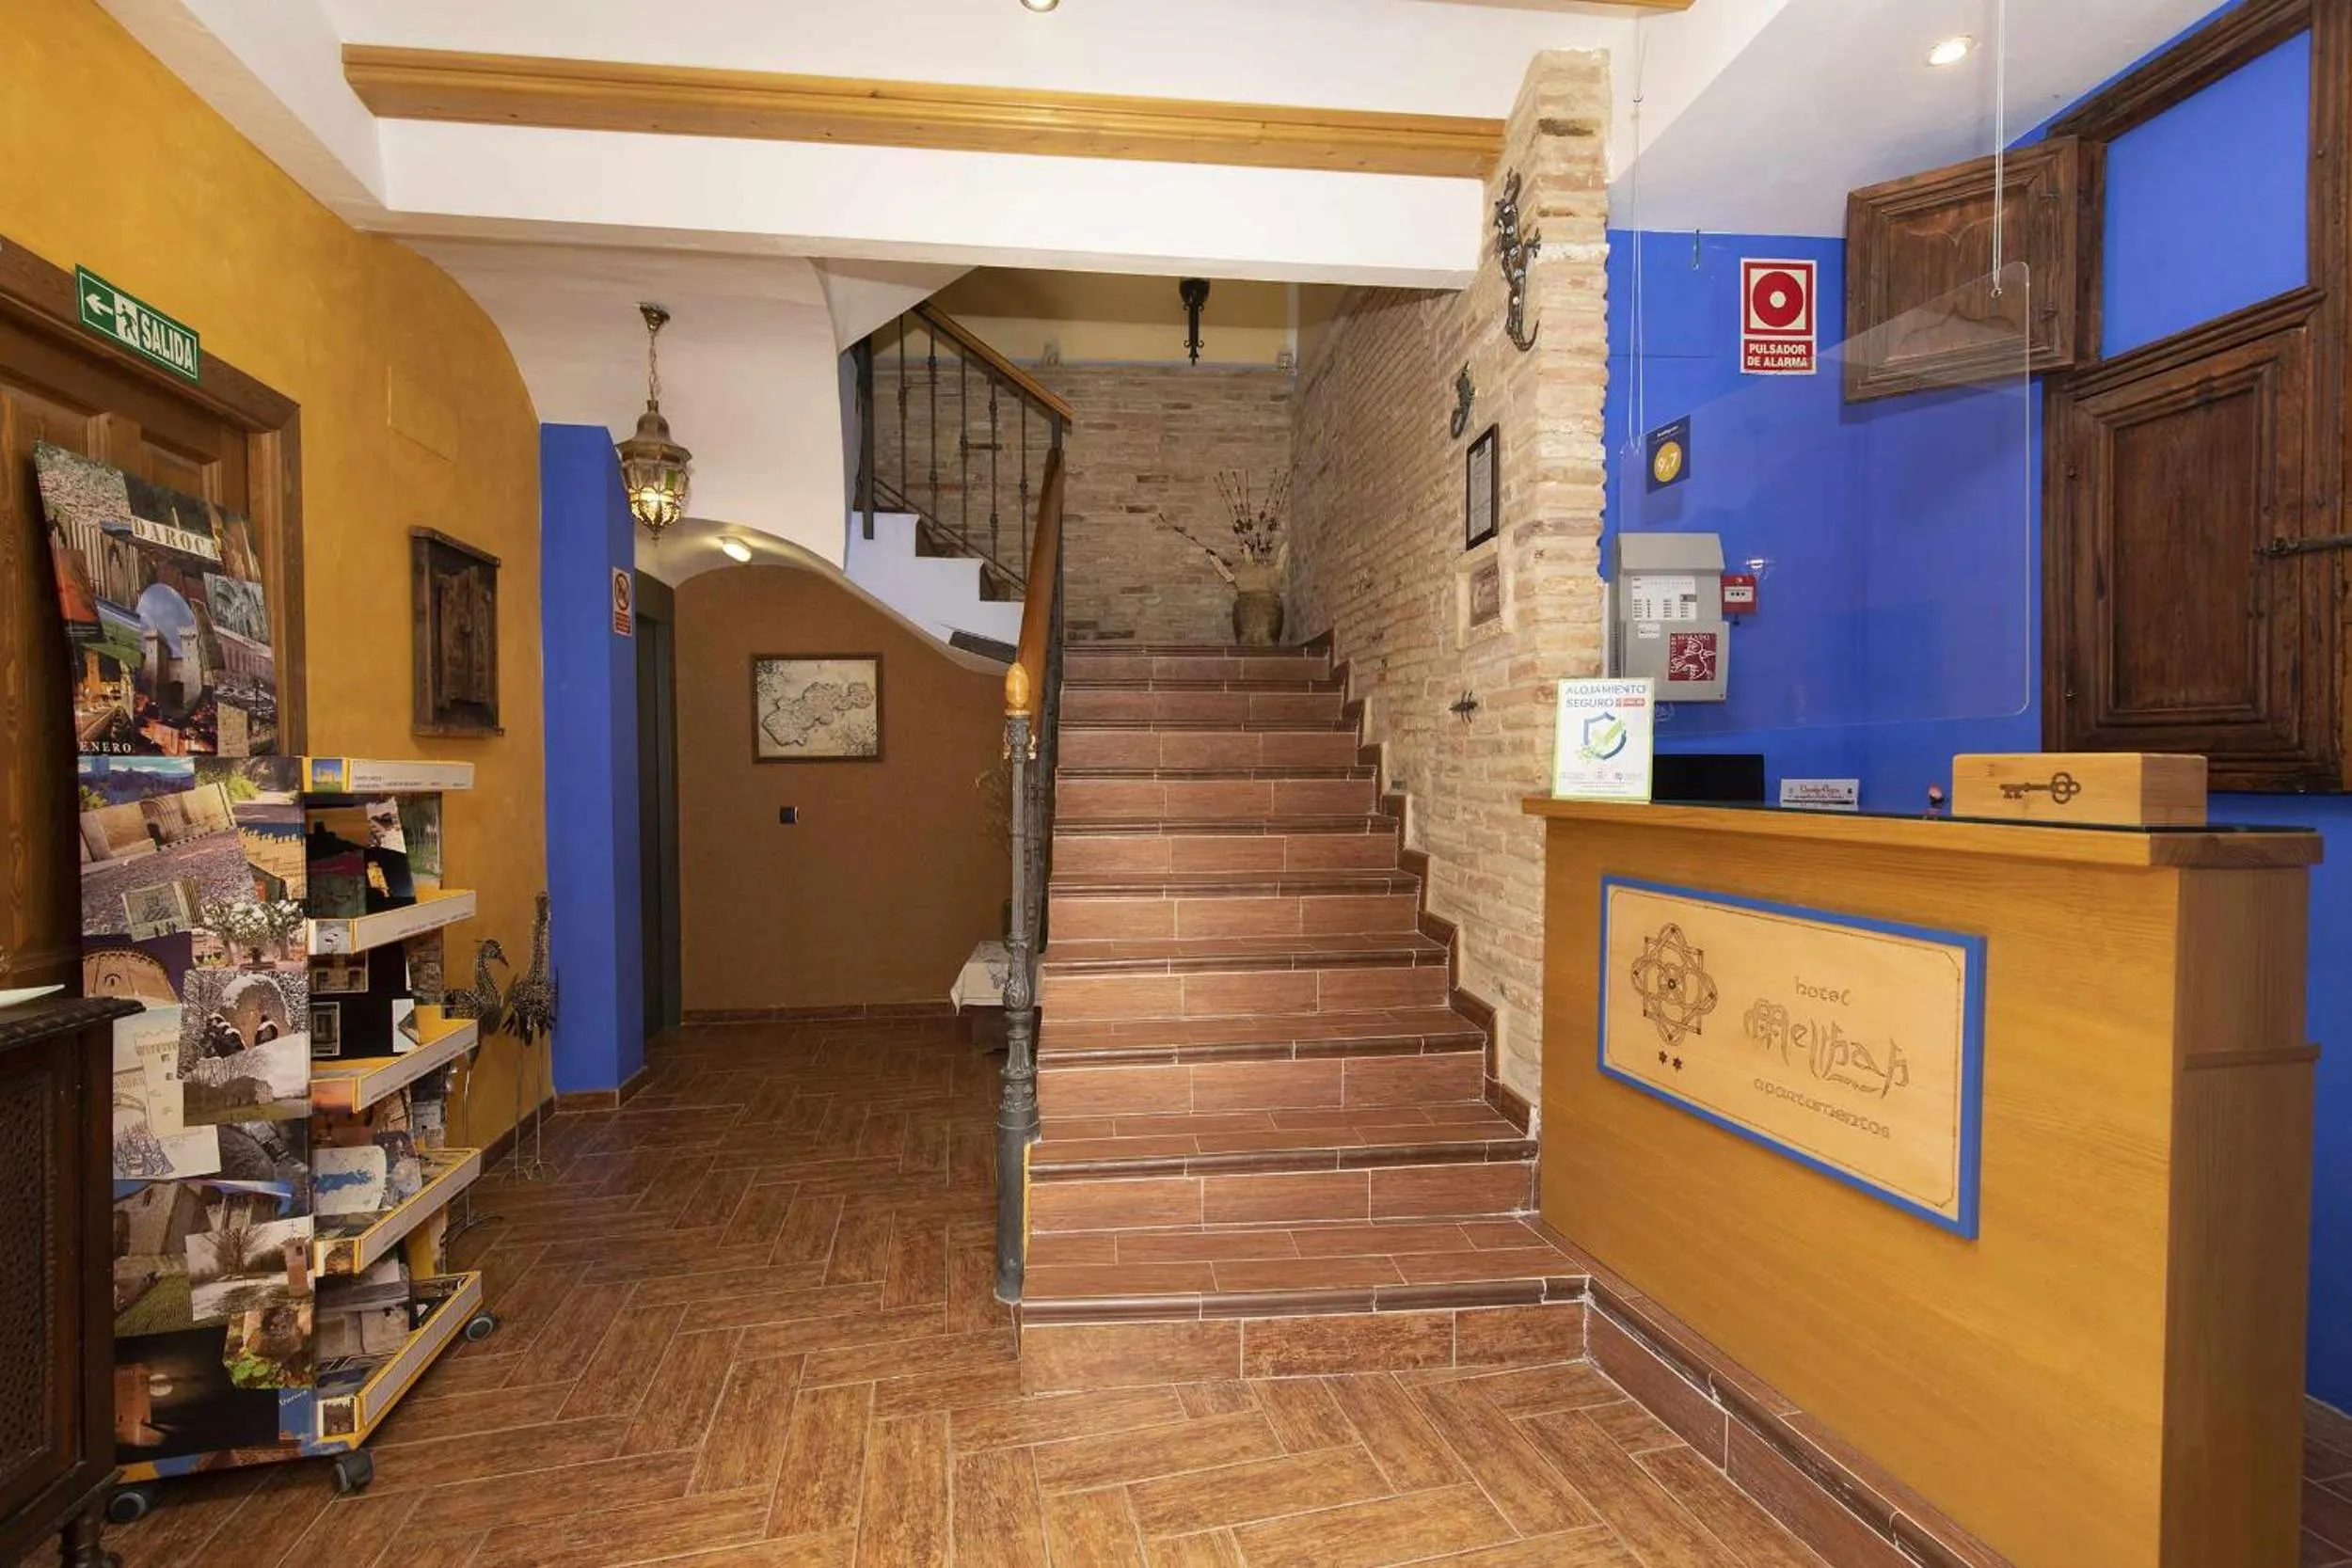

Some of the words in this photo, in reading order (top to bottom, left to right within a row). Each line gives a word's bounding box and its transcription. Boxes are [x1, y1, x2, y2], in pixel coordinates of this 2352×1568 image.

[141, 312, 194, 372] SALIDA
[1749, 343, 1806, 355] PULSADOR
[1747, 356, 1761, 366] DE
[1763, 357, 1808, 368] ALARMA
[133, 518, 221, 560] DAROCA
[1565, 685, 1645, 695] ALOJAMIENTO
[1566, 698, 1613, 708] SEGURO
[79, 741, 131, 752] ENERO
[1794, 975, 1851, 1006] hotel
[1754, 1078, 1890, 1139] apartamentos
